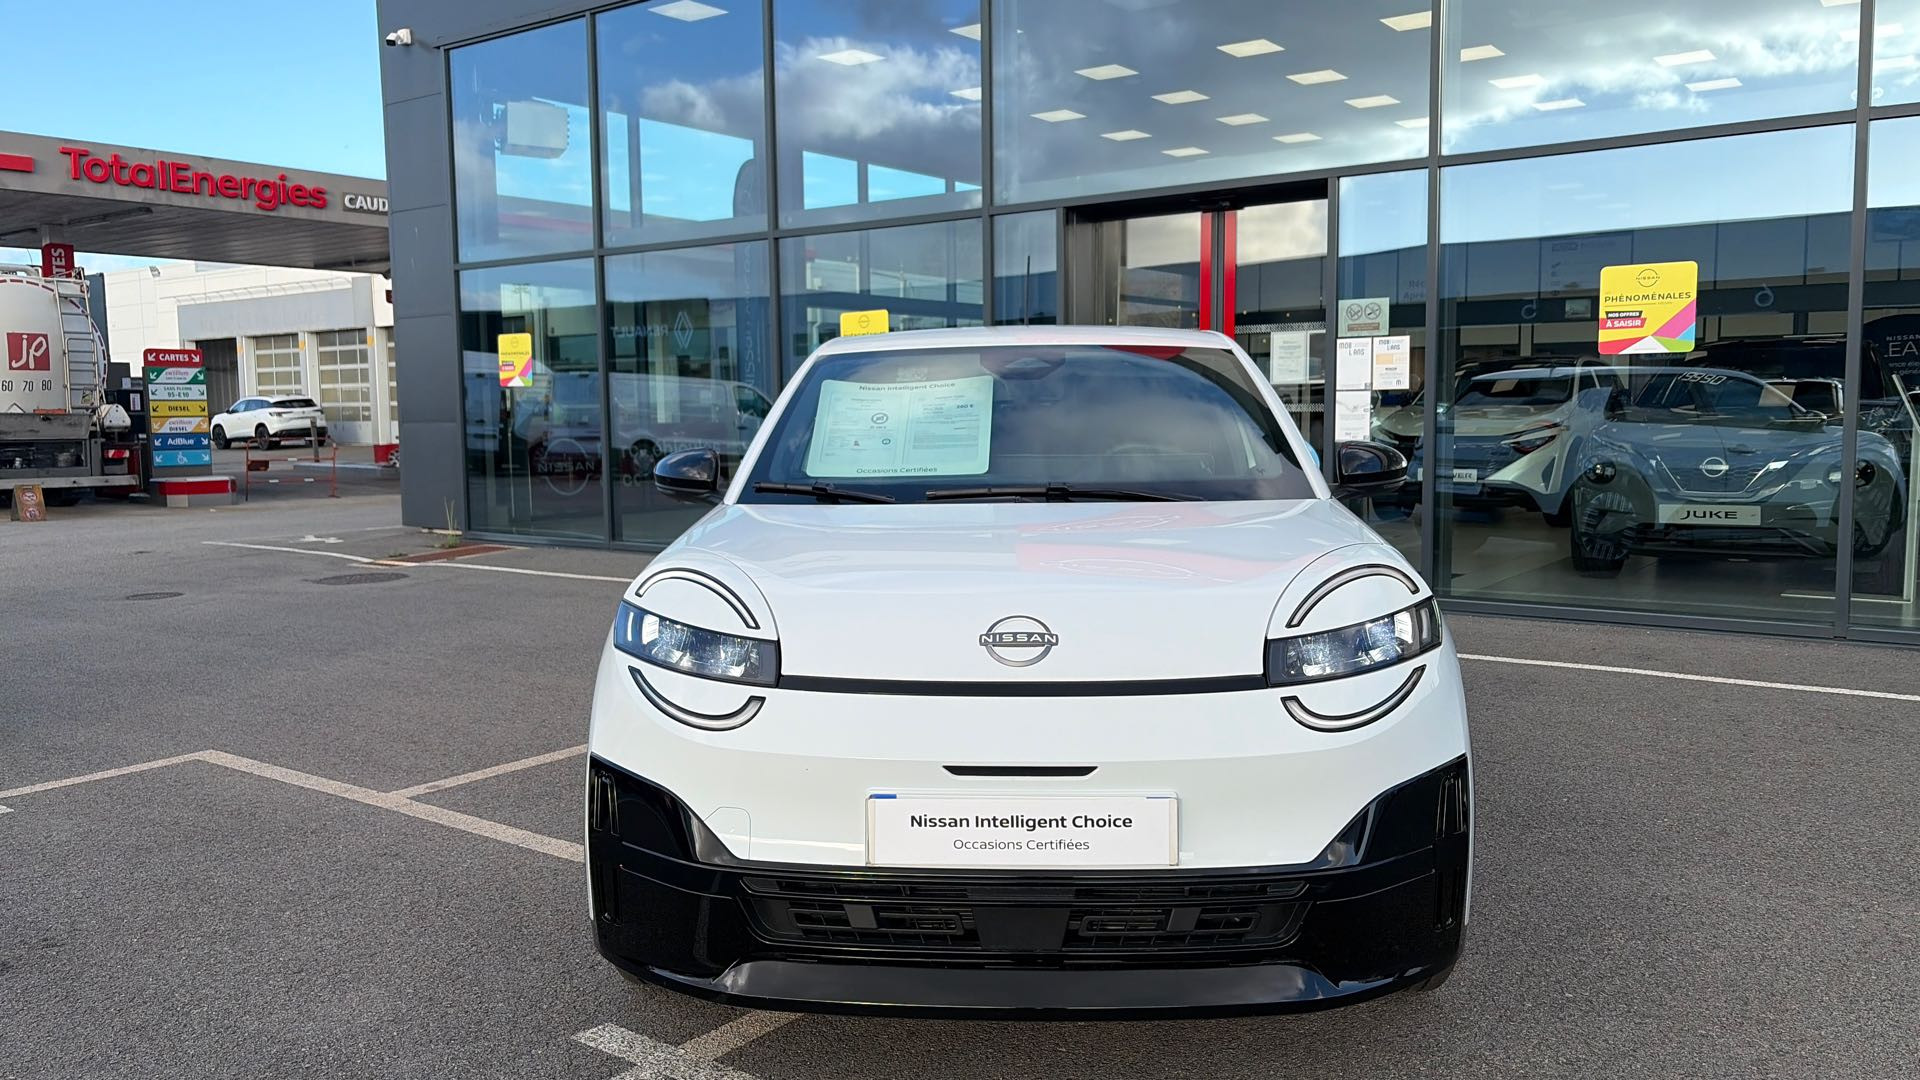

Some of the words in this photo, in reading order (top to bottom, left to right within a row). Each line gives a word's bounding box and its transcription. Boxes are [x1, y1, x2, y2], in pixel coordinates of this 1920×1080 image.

[60, 146, 328, 211] TotalEnergies
[344, 194, 389, 212] CAUD
[1604, 291, 1691, 303] PHÉNOMÉNALES
[1606, 319, 1612, 328] À
[1613, 319, 1642, 328] SAISIR
[1, 380, 14, 392] 60
[22, 380, 34, 393] 70
[41, 379, 52, 391] 80
[167, 437, 195, 445] AdBlue
[537, 461, 595, 473] NISSAN
[1680, 510, 1738, 519] JUKE
[981, 633, 1057, 643] NISSAN
[910, 814, 970, 829] Nissan
[974, 814, 1067, 832] Intelligent
[1071, 814, 1133, 829] Choice
[953, 839, 1023, 850] Occasions
[1026, 838, 1090, 850] Certifiées
